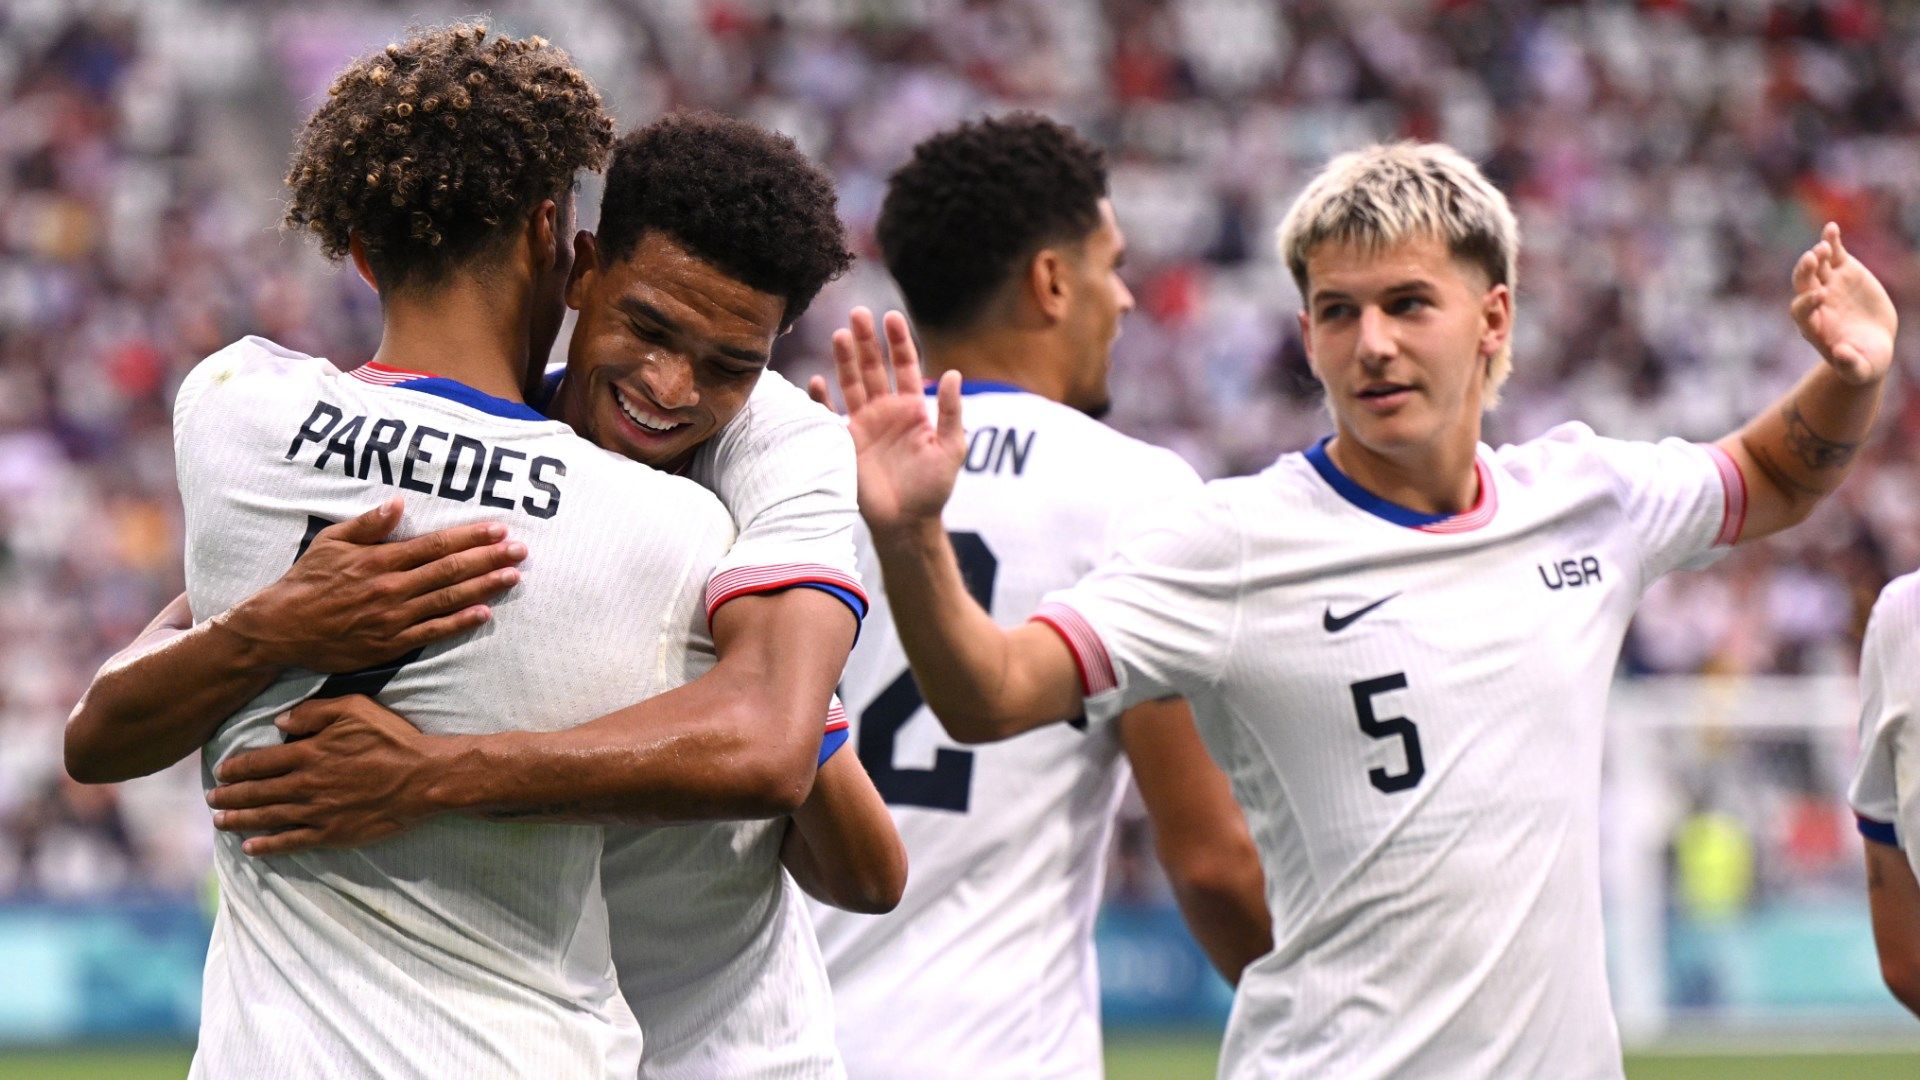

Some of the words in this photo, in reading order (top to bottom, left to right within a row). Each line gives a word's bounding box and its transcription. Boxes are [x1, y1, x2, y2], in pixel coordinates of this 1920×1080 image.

[286, 401, 567, 519] PAREDES
[962, 427, 1036, 475] ON
[1538, 556, 1602, 590] USA
[836, 529, 998, 813] 2
[1350, 671, 1425, 794] 5
